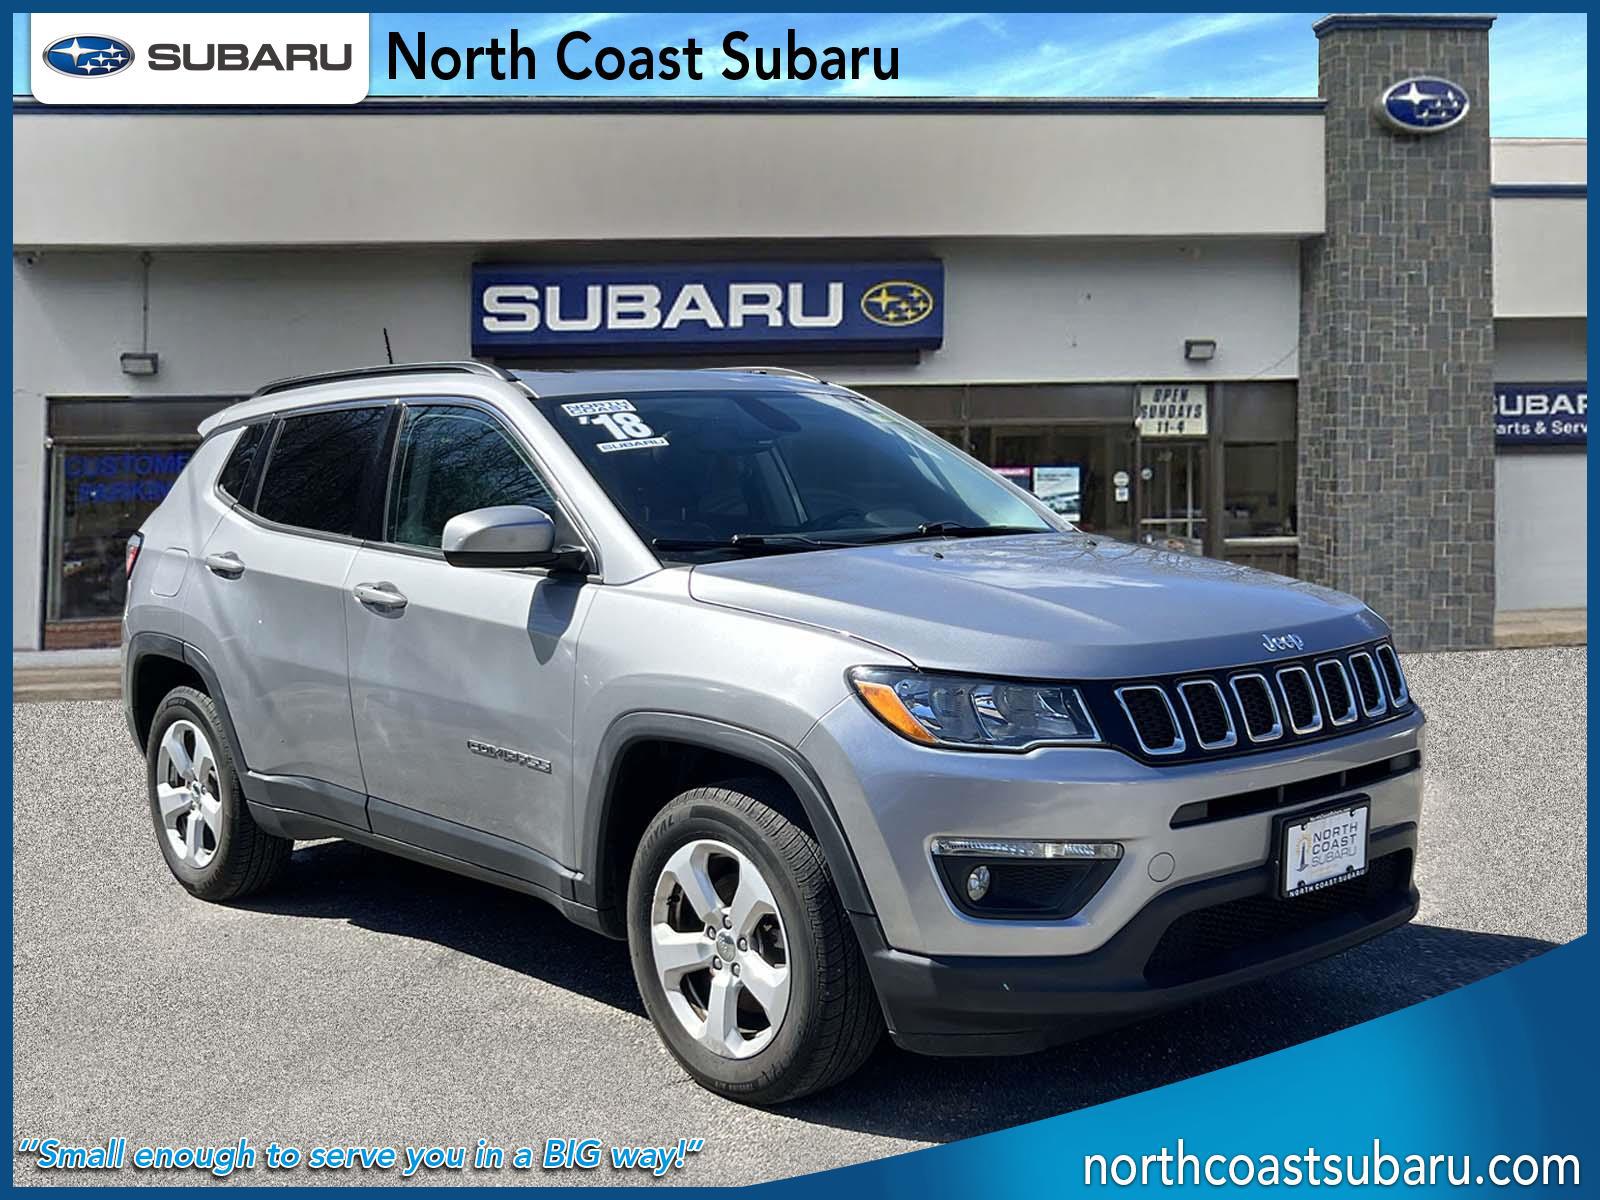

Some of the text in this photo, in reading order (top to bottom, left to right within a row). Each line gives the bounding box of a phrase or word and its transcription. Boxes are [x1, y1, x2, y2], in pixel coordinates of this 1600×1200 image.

[482, 282, 844, 333] SUBARU
[1152, 388, 1189, 403] OPEN
[1139, 404, 1202, 419] SUNDAYS
[578, 412, 653, 440] '18
[1494, 422, 1531, 435] arts
[1534, 421, 1547, 435] &
[601, 440, 665, 450] SUBARU
[64, 453, 192, 478] CUSTOME
[1262, 633, 1304, 652] Jeep
[467, 739, 552, 775] COMPASS
[1312, 821, 1358, 842] NORTH
[1312, 834, 1357, 856] COAST
[1311, 846, 1358, 868] SUBARU
[1289, 885, 1314, 897] NORTH
[1315, 878, 1338, 890] COAST
[1338, 869, 1366, 884] SUBARU
